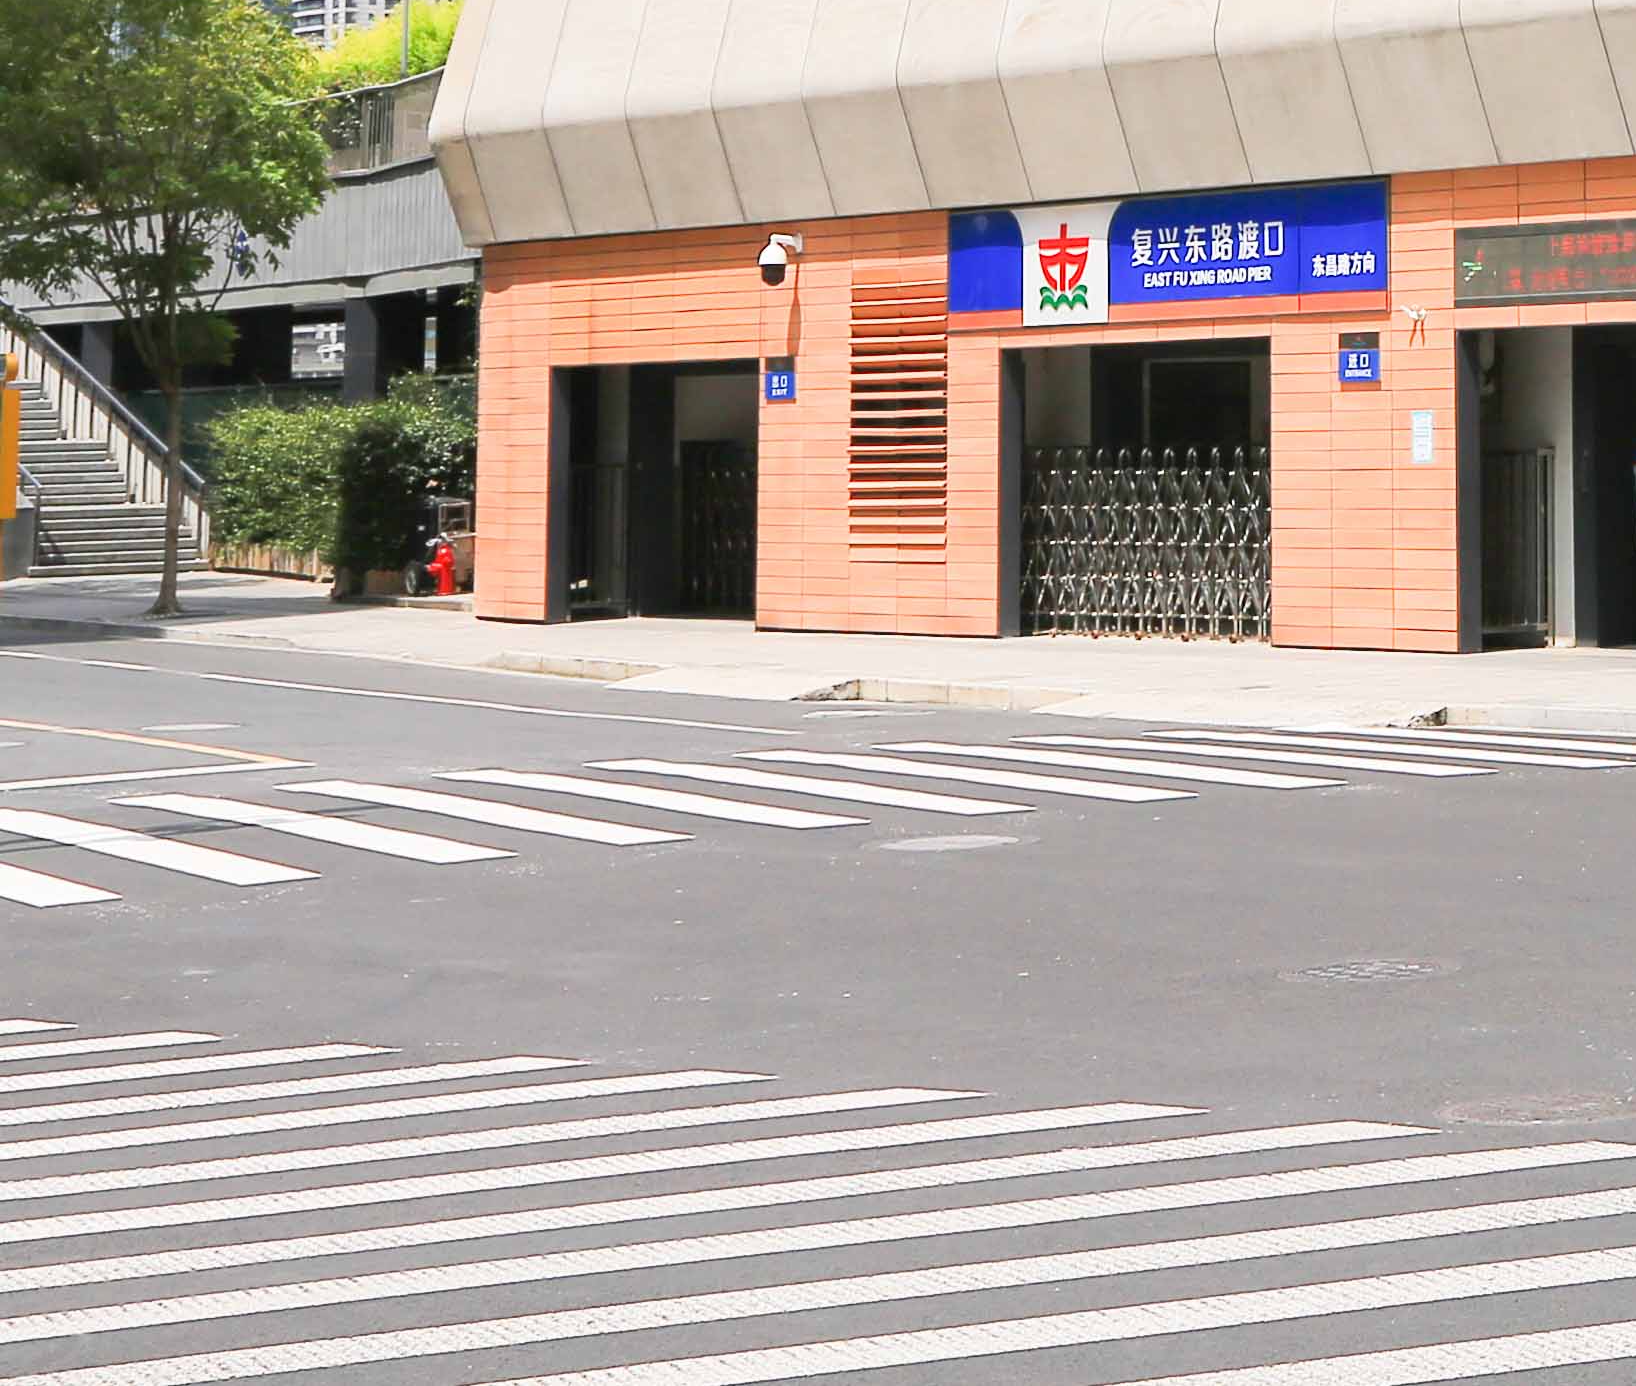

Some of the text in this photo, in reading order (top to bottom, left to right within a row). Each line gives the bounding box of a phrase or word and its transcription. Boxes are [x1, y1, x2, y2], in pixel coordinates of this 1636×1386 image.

[1131, 221, 1285, 267] 复兴东路渡口
[1144, 266, 1272, 288] EAST FU XING ROAD PIER
[1311, 251, 1376, 277] 东昌路方向
